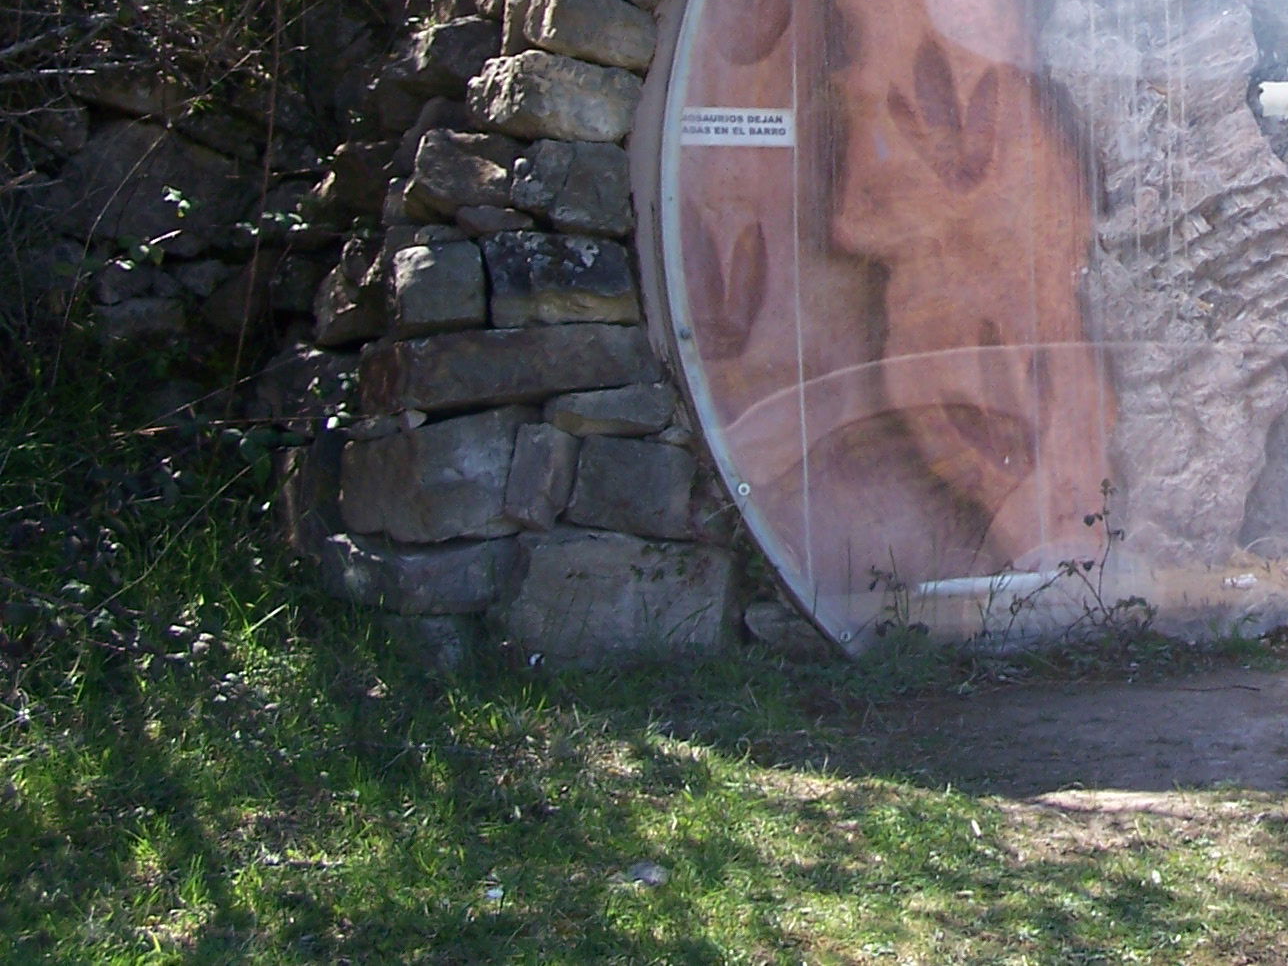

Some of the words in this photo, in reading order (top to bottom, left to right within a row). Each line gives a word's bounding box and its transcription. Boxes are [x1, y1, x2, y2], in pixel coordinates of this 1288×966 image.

[747, 115, 783, 124] DEJAN
[714, 126, 729, 135] EN
[732, 127, 745, 136] EL
[749, 127, 787, 136] BARRO
